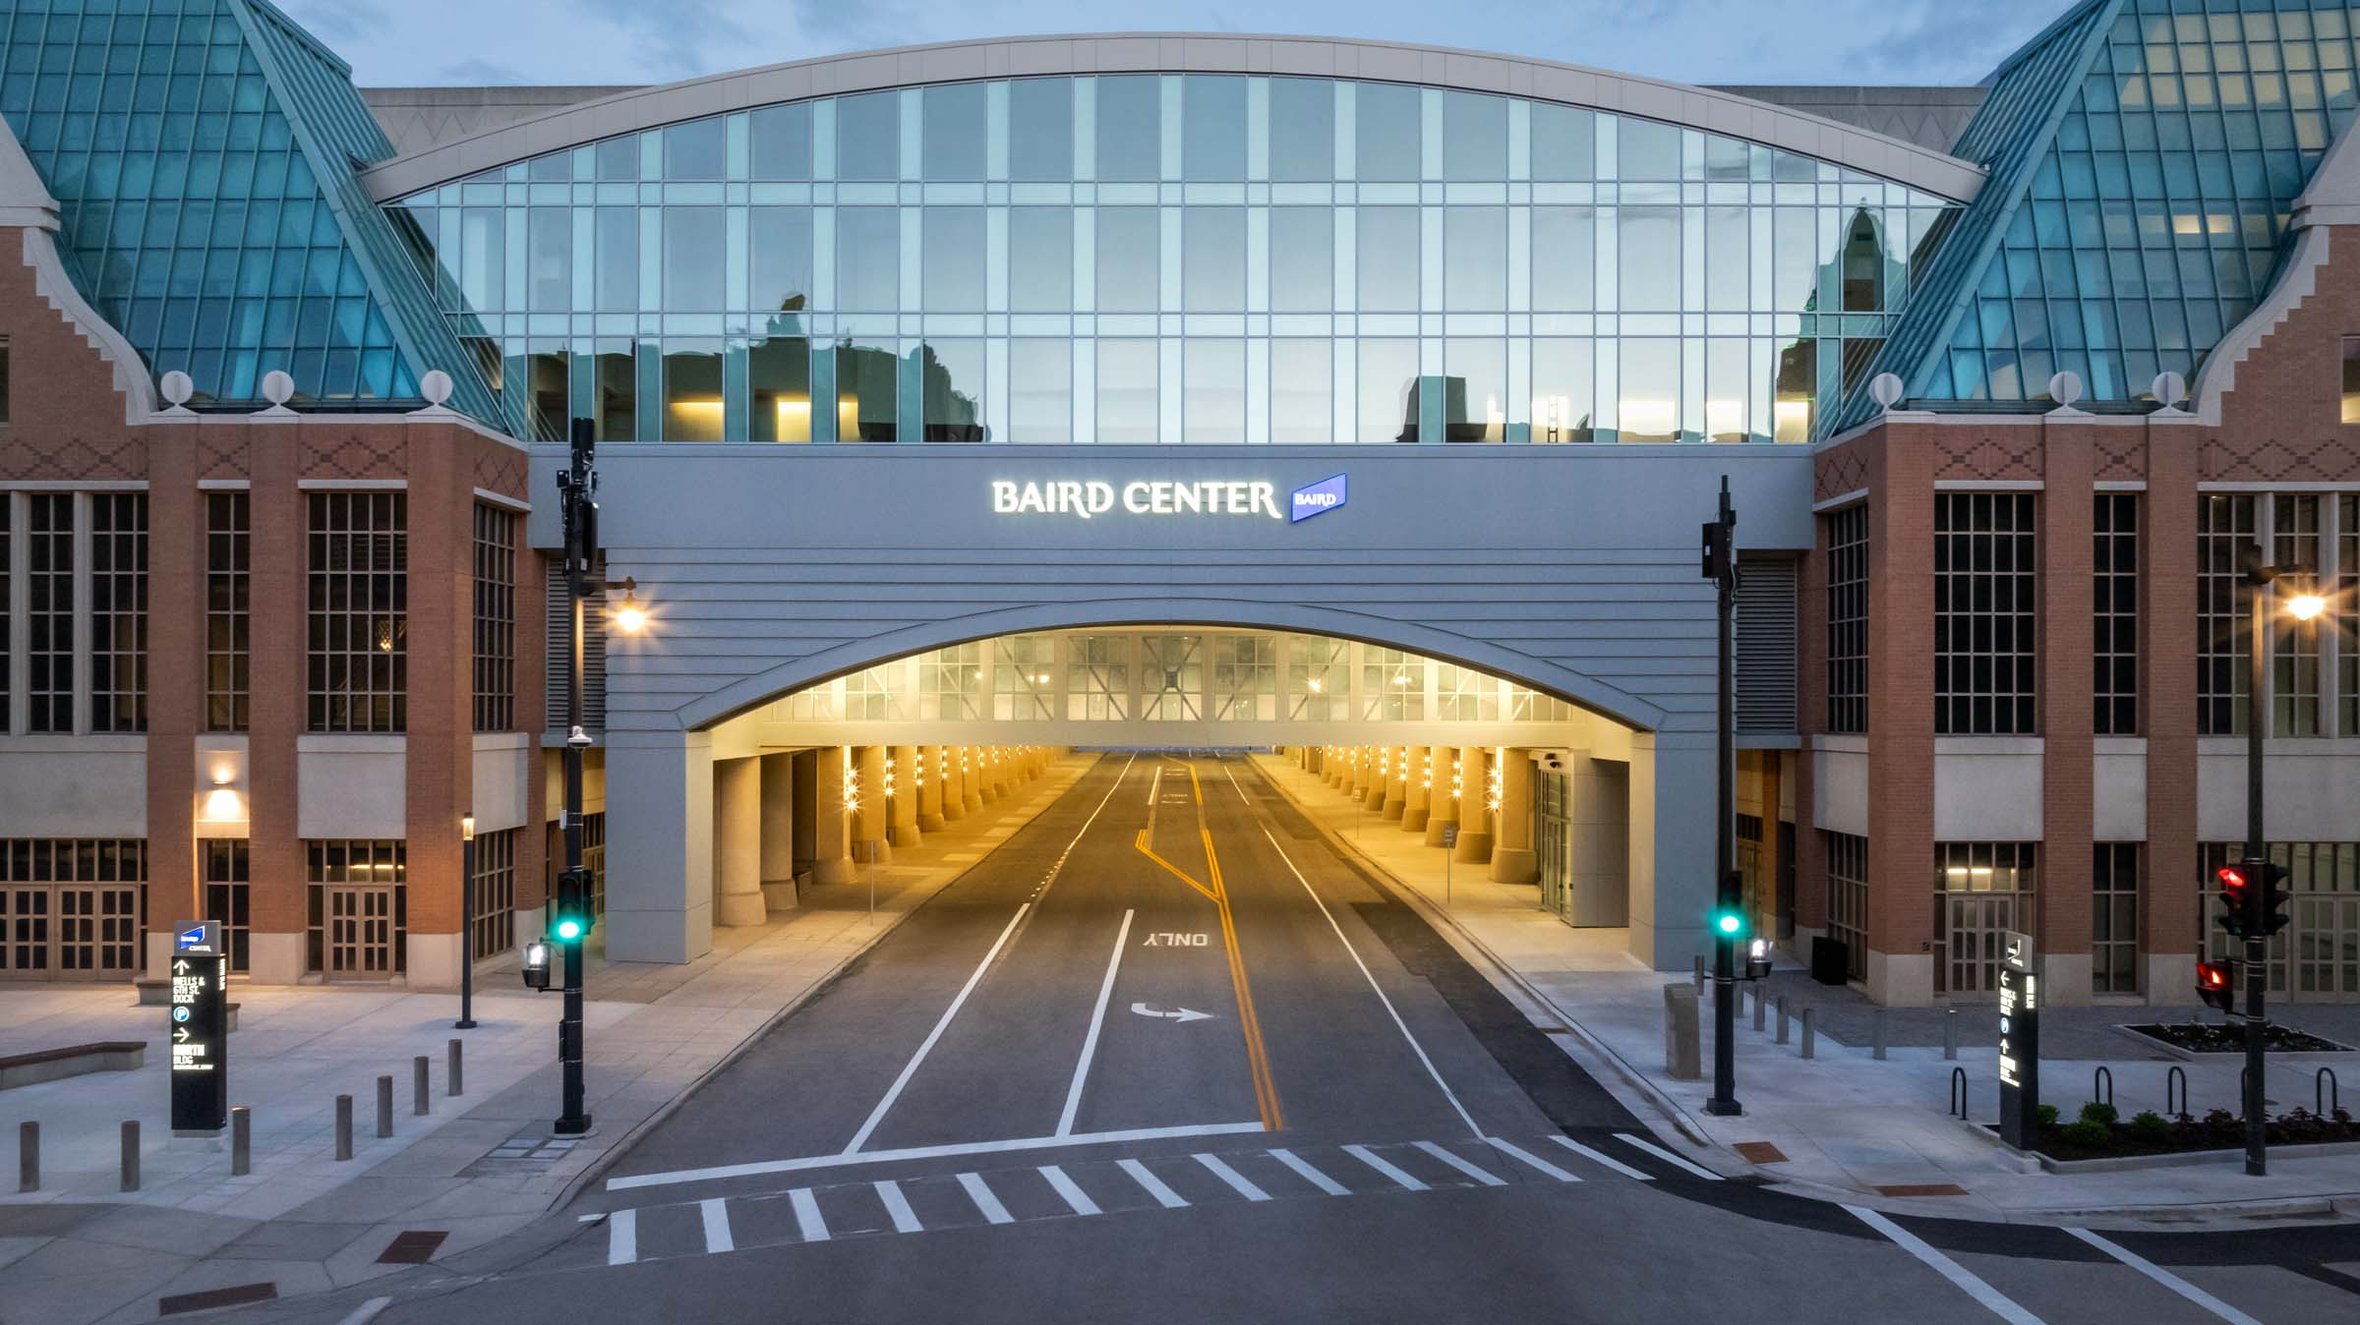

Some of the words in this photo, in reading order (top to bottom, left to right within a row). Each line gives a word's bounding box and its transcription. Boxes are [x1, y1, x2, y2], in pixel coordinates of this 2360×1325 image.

[993, 481, 1114, 518] BAIRD
[1123, 481, 1282, 518] CENTER
[1294, 492, 1336, 508] BAIRD
[1143, 932, 1209, 946] ONLY
